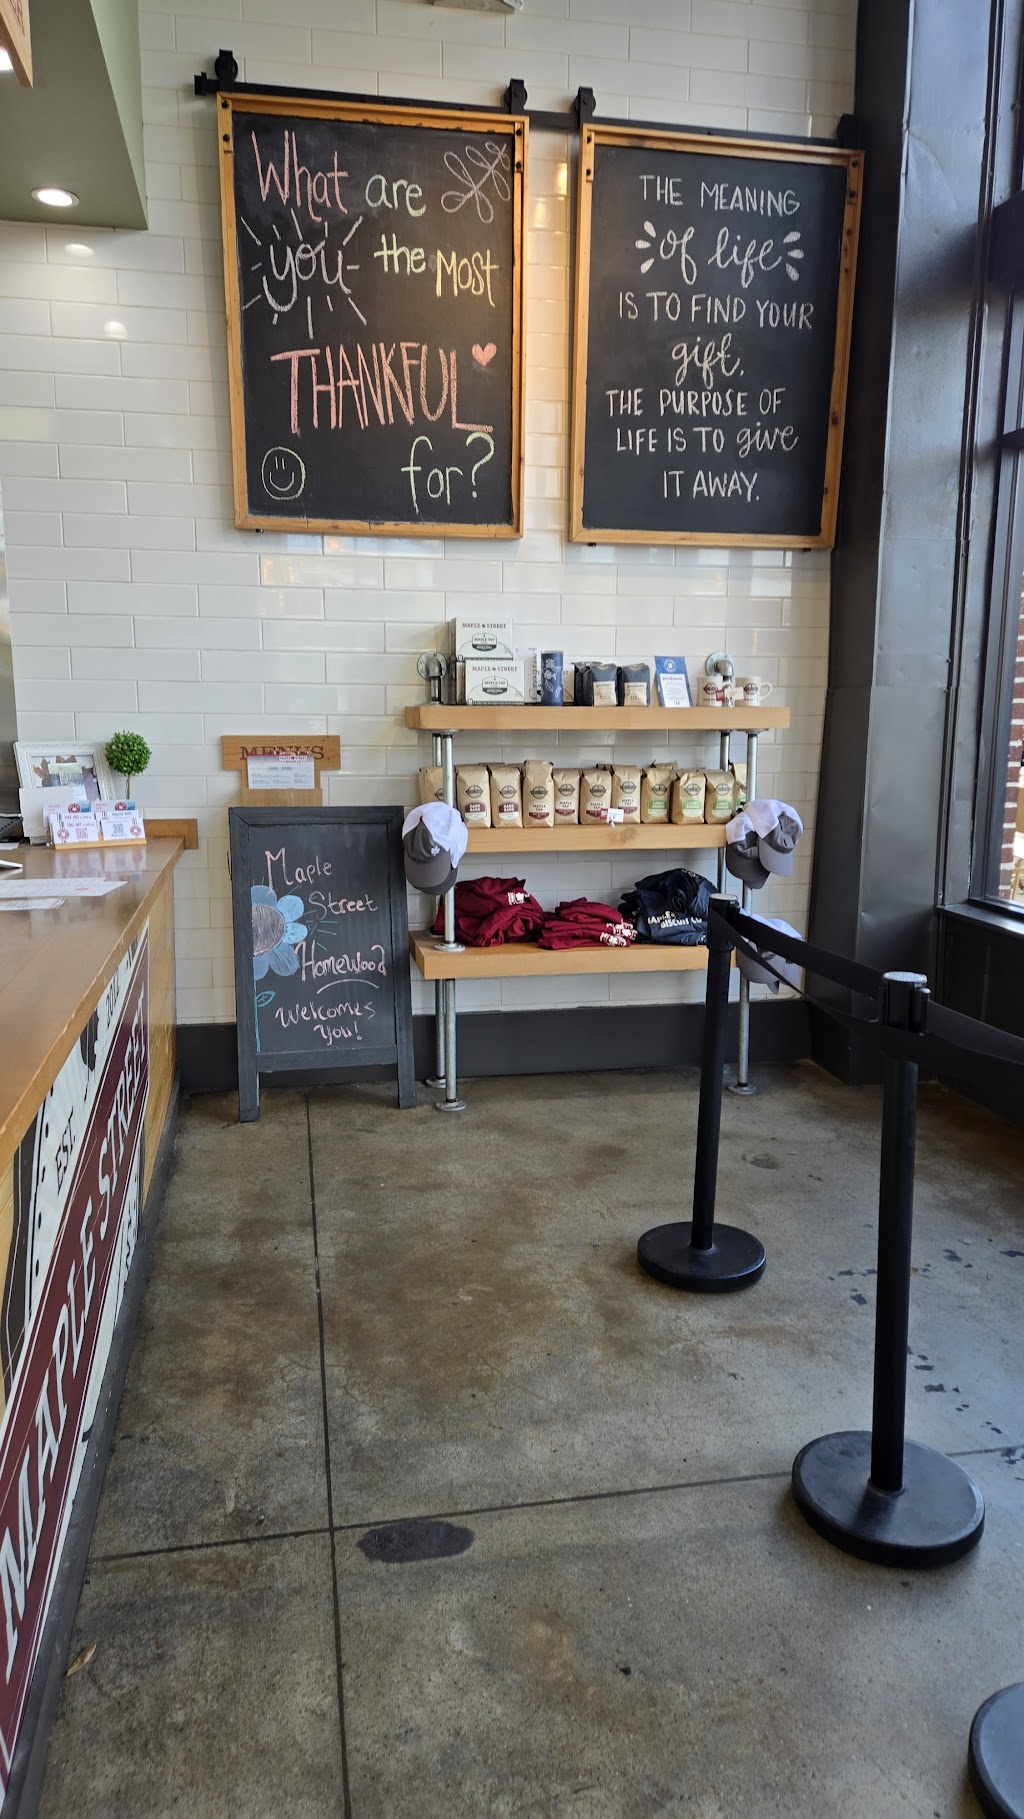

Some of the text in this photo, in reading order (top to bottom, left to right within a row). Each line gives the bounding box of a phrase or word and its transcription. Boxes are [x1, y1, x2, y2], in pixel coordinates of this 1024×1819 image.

[252, 130, 426, 222] What are
[639, 175, 800, 217] THE MEANING
[263, 240, 351, 312] you
[374, 233, 427, 275] the
[660, 226, 782, 288] of life
[619, 291, 814, 329] IS TO FIND YOUR
[672, 333, 744, 389] gift.
[270, 342, 494, 434] THANKFUL
[606, 388, 786, 417] THE PURPOSE OF
[616, 422, 799, 458] LIFE IS TO give
[401, 432, 495, 515] for?
[663, 470, 760, 502] IT AWAY.
[265, 847, 332, 893] Maple
[308, 890, 378, 920] Street
[0, 980, 146, 1686] MAPLE STREET
